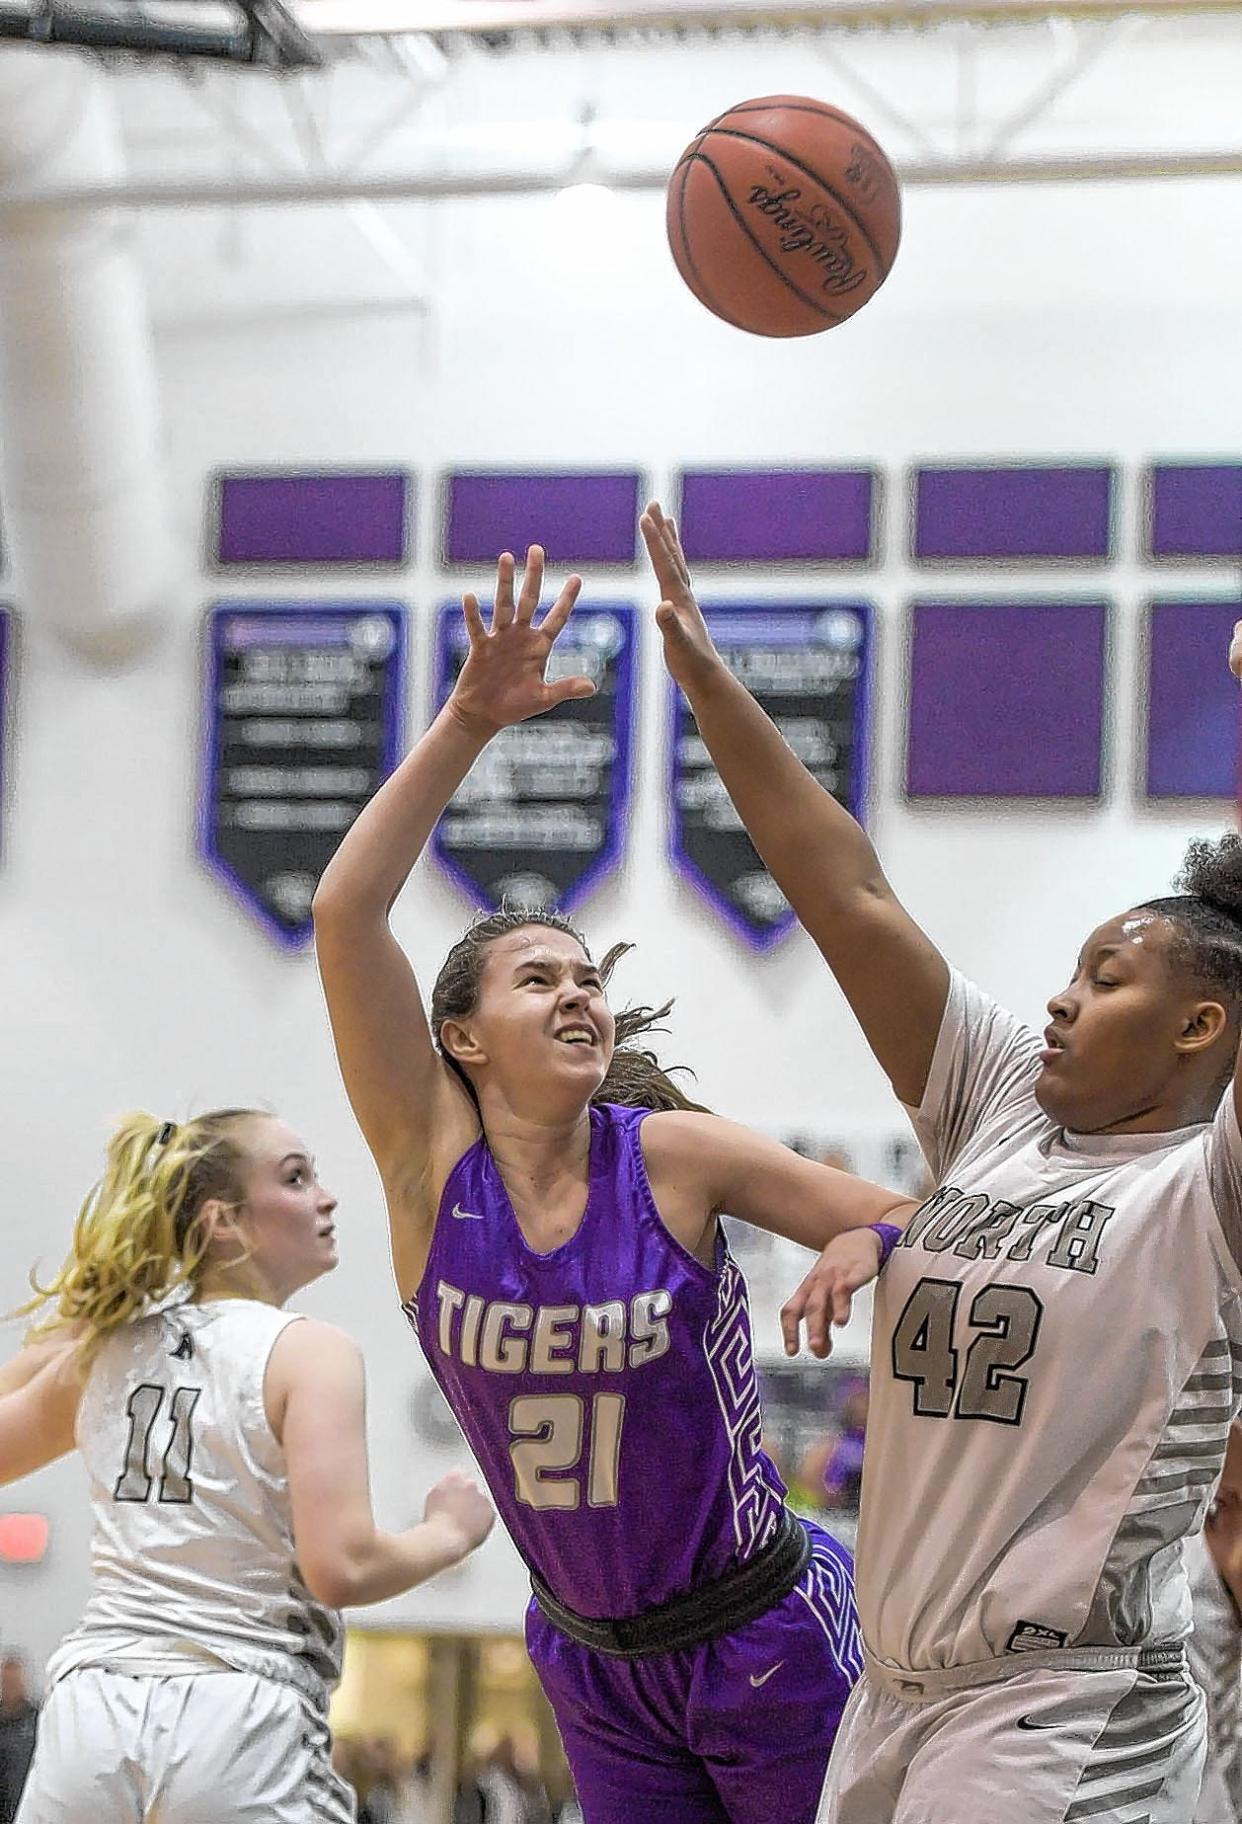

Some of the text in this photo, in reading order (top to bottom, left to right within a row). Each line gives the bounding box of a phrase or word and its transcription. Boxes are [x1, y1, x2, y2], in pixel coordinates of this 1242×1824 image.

[747, 185, 868, 296] Rawlings
[895, 1185, 1116, 1275] NORTH
[436, 1279, 672, 1375] TIGERS
[891, 1276, 1044, 1427] 42
[113, 1384, 202, 1504] 11
[508, 1391, 626, 1512] 21
